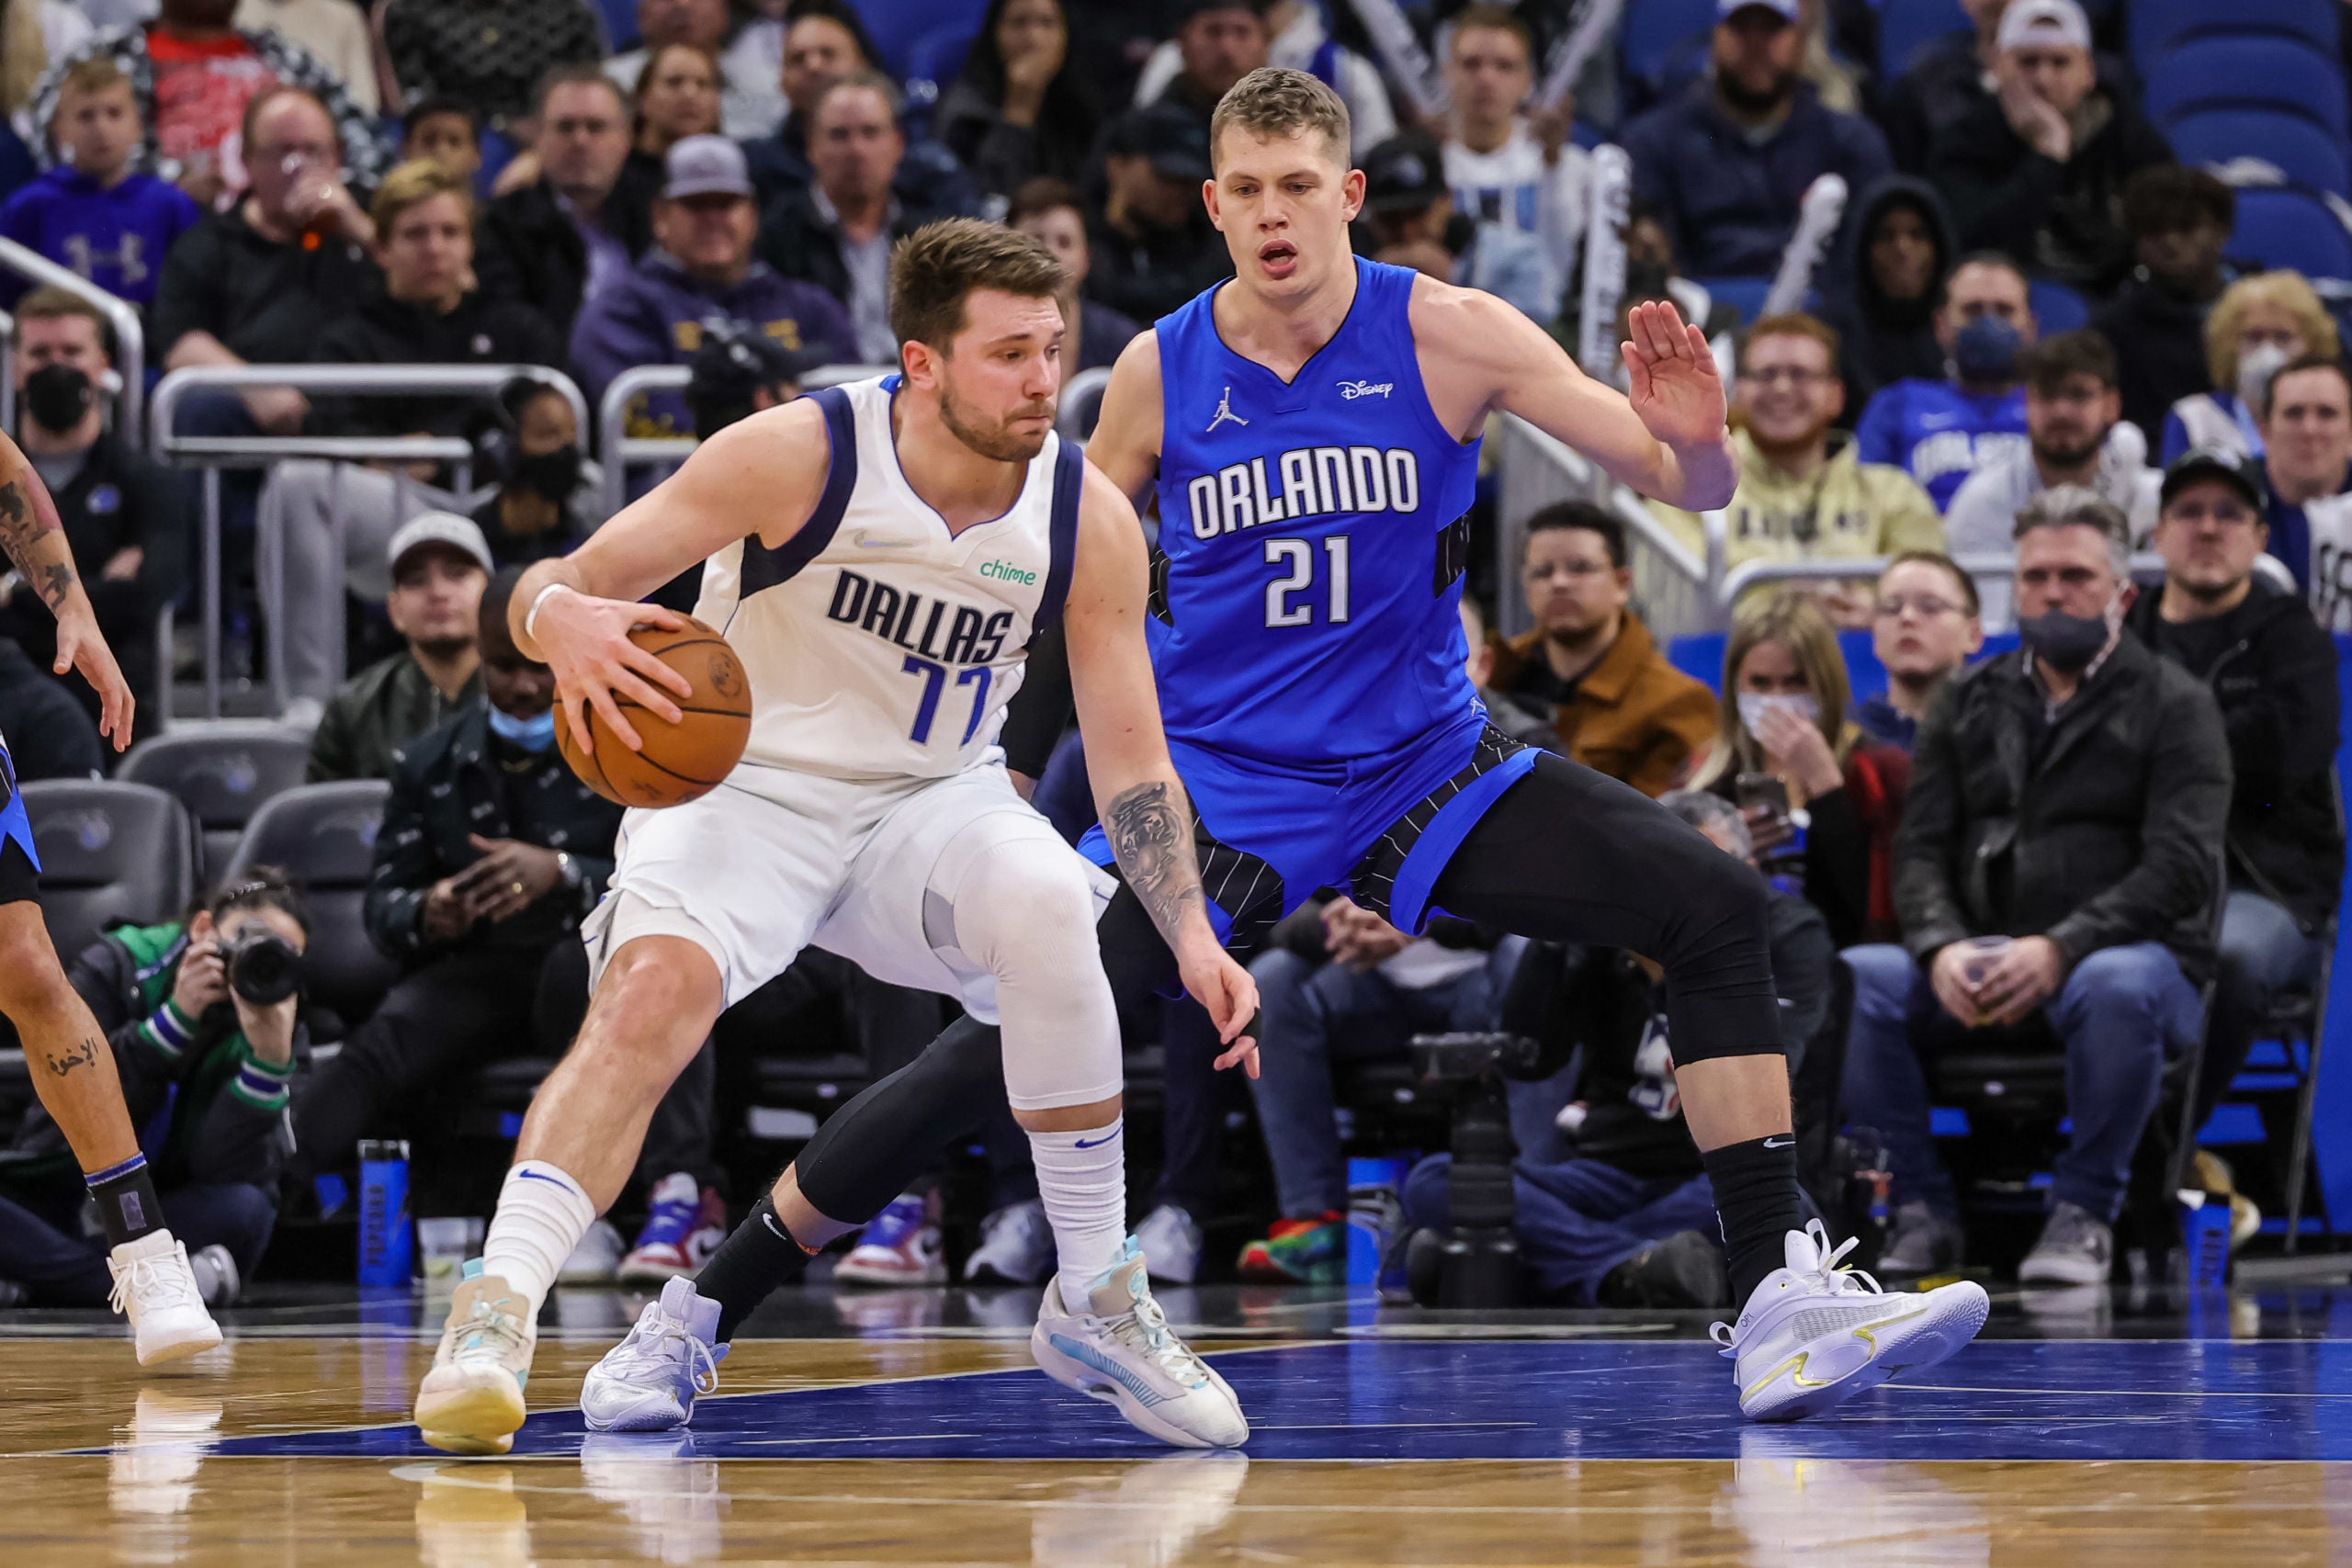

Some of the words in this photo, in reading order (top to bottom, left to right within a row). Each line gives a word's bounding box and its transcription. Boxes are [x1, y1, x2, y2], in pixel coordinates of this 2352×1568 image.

[1188, 446, 1419, 540] ORLANDO
[827, 567, 1015, 664] DALLAS
[979, 559, 1036, 586] chime
[1264, 534, 1350, 628] 21
[901, 652, 992, 750] 77
